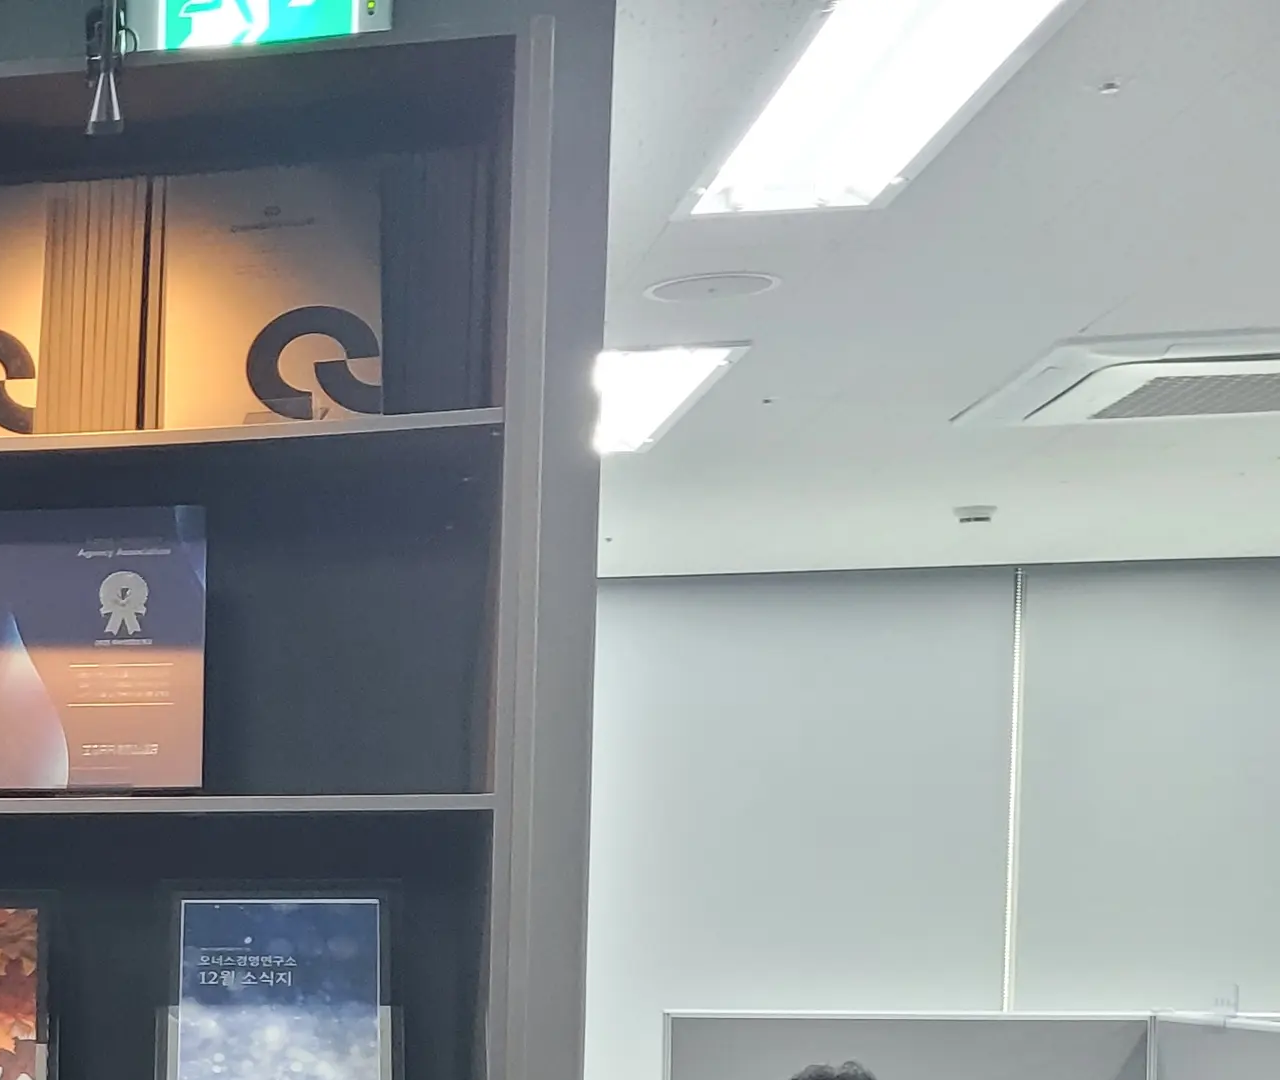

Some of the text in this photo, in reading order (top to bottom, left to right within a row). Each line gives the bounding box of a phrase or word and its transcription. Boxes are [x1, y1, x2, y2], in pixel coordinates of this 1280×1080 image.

[196, 955, 298, 968] 오너스경영연구소
[199, 970, 292, 987] 12월 소식지
